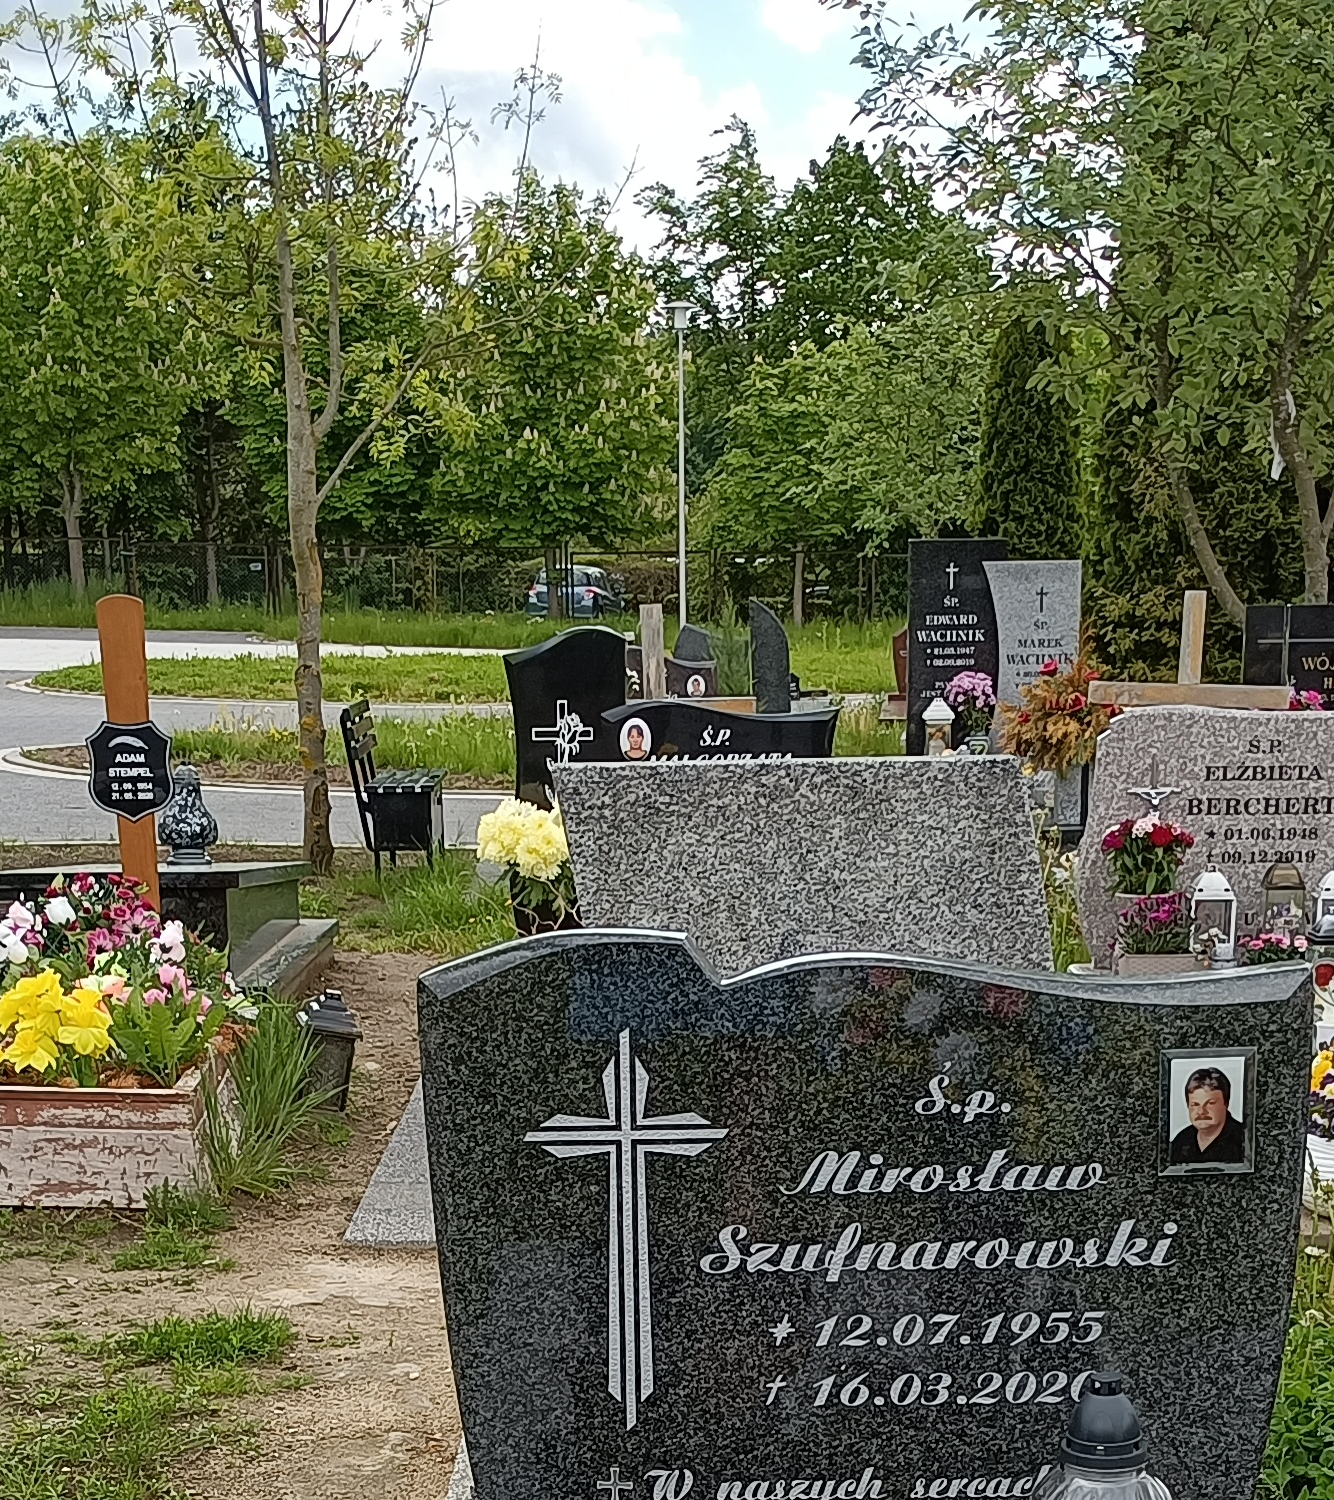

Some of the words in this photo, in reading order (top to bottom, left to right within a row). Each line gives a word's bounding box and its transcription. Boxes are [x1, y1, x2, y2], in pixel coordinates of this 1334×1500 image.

[925, 614, 978, 626] EDWARD
[917, 629, 985, 643] WACHNIK
[1017, 638, 1063, 649] MAREK
[699, 724, 731, 747] Ś.P.
[1247, 734, 1283, 754] Ś.P.
[114, 753, 146, 763] ADAM
[108, 767, 154, 777] STEMPEL
[1203, 761, 1326, 782] ELŻBIETA
[914, 1060, 1012, 1124] Ś.p.
[778, 1149, 1110, 1196] Mirosław
[699, 1218, 1178, 1283] Szufnarowski
[814, 1311, 1106, 1348] 12.07.1955
